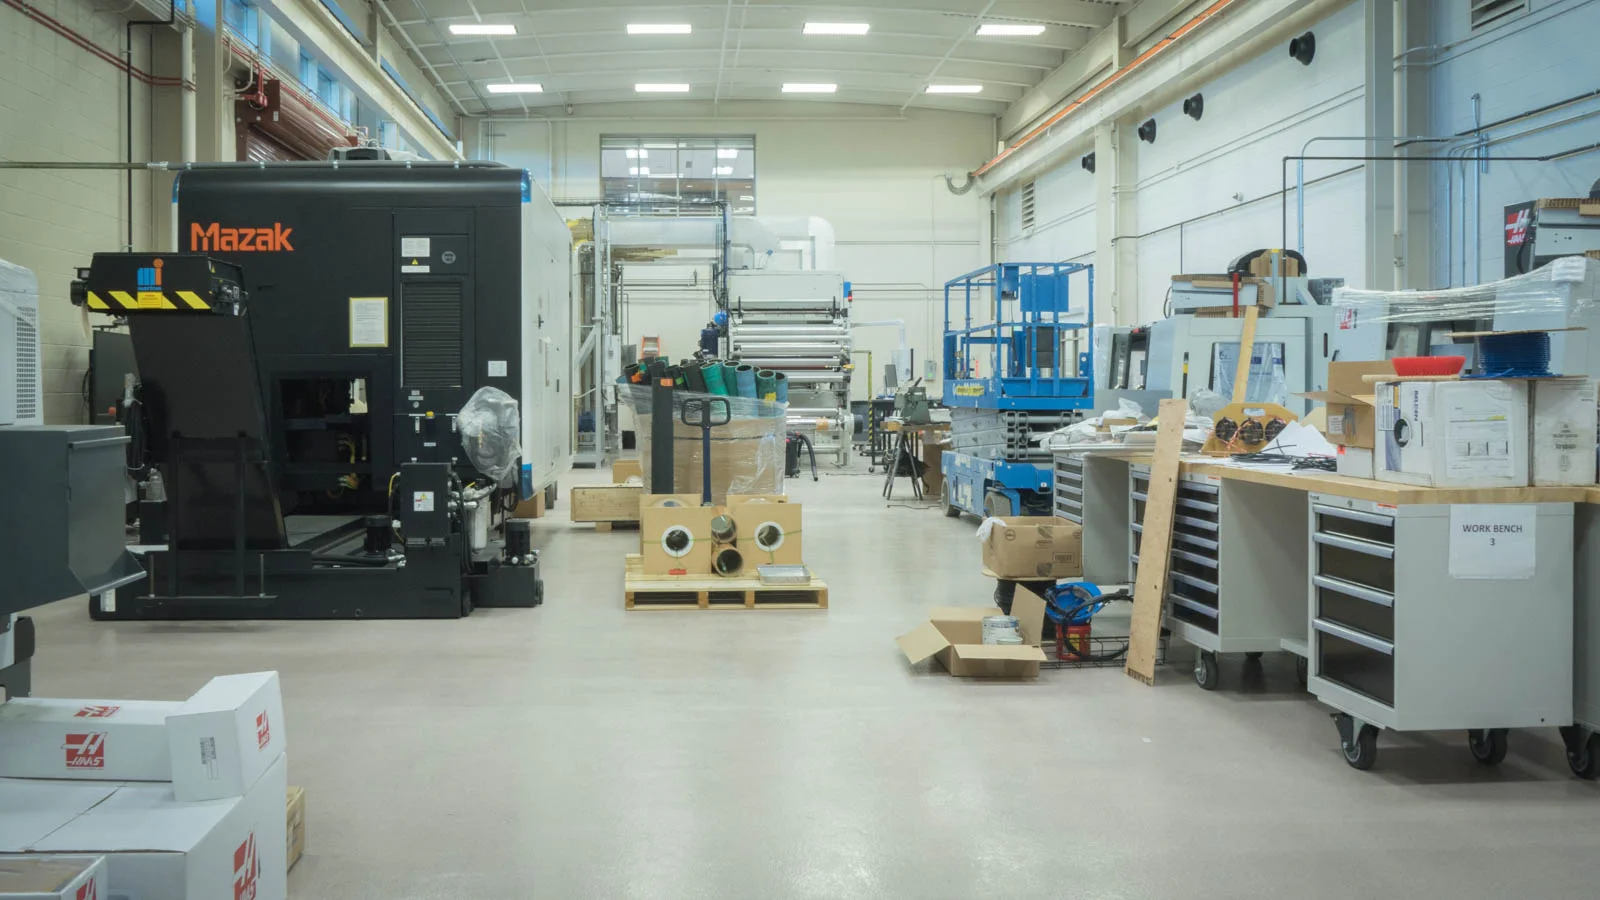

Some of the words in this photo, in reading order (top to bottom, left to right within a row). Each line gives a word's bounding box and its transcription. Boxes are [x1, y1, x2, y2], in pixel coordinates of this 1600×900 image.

[190, 222, 294, 251] Mazak
[1462, 524, 1491, 533] WORK
[1493, 524, 1523, 533] BENCH
[1489, 537, 1496, 546] 3
[65, 756, 105, 767] HAAS
